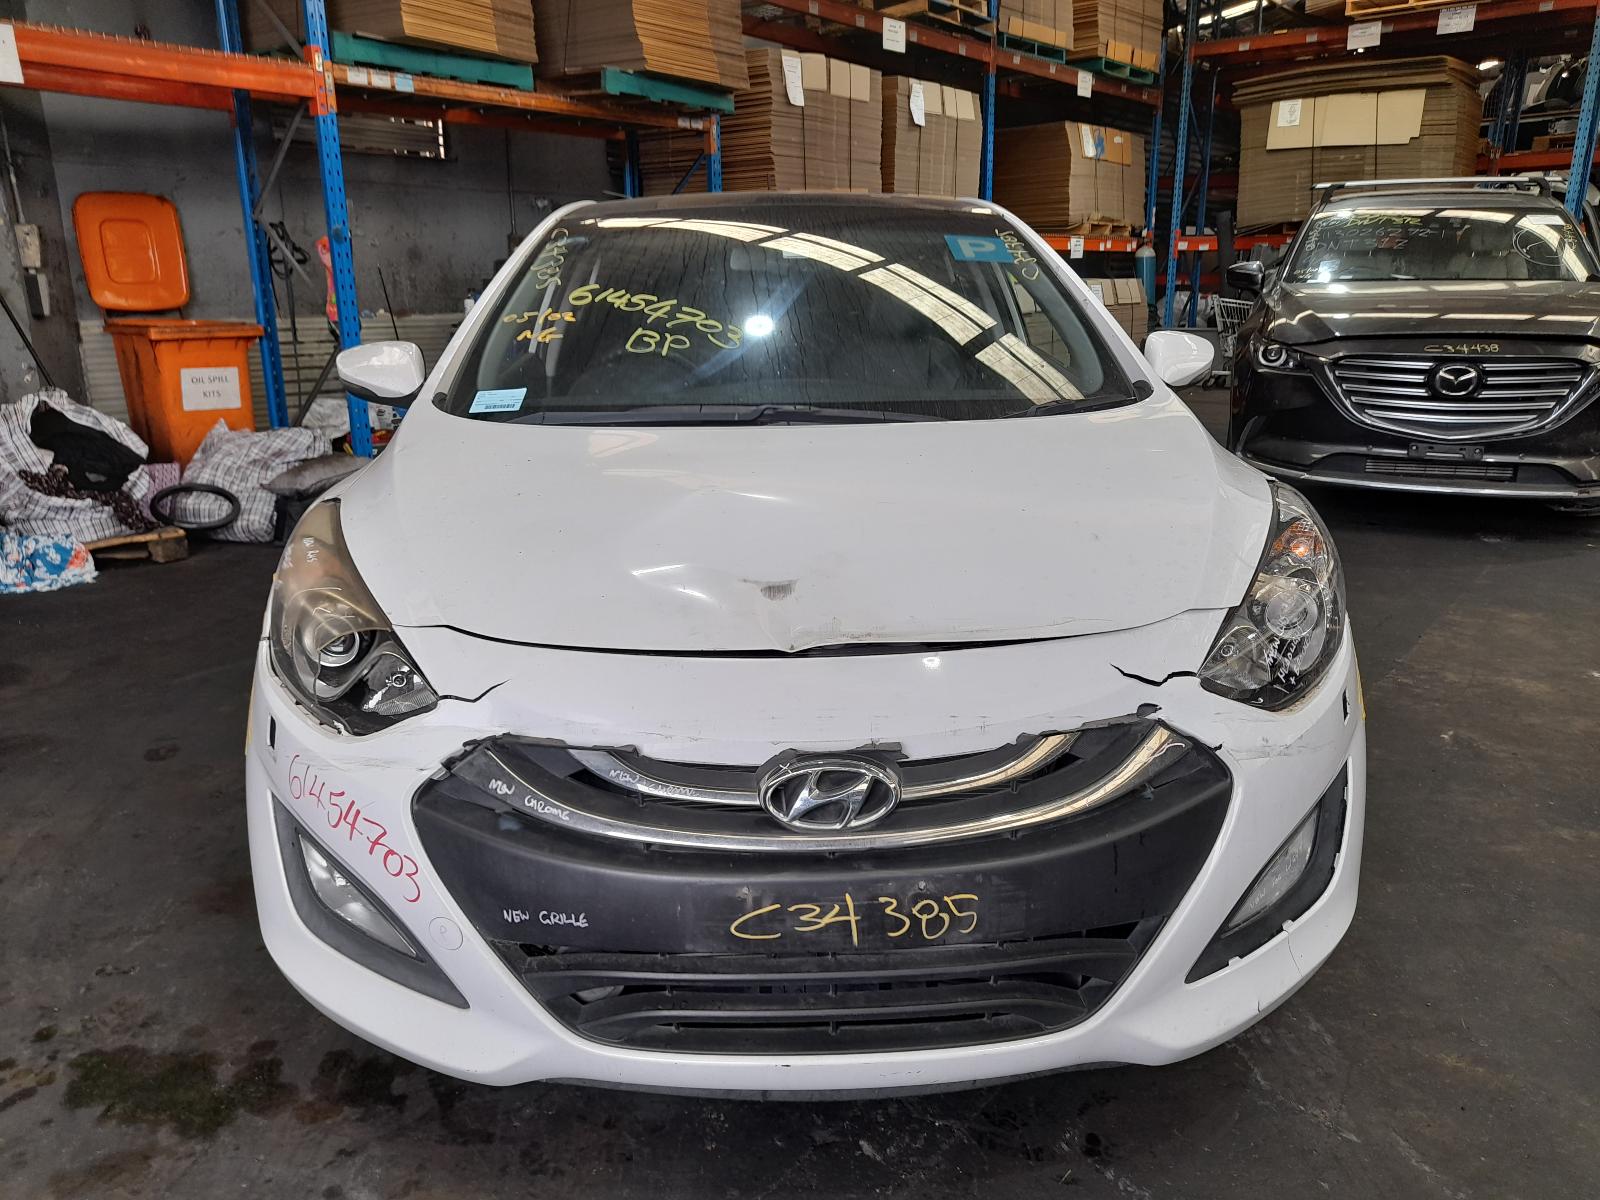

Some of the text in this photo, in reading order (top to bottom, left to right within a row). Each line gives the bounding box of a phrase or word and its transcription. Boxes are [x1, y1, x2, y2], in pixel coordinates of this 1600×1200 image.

[568, 283, 743, 349] 61454703
[625, 327, 690, 356] BP
[191, 375, 229, 384] OIL SPILL
[203, 390, 221, 398] KITS
[288, 754, 421, 903] 61454703
[503, 909, 589, 928] NEW GRILLE
